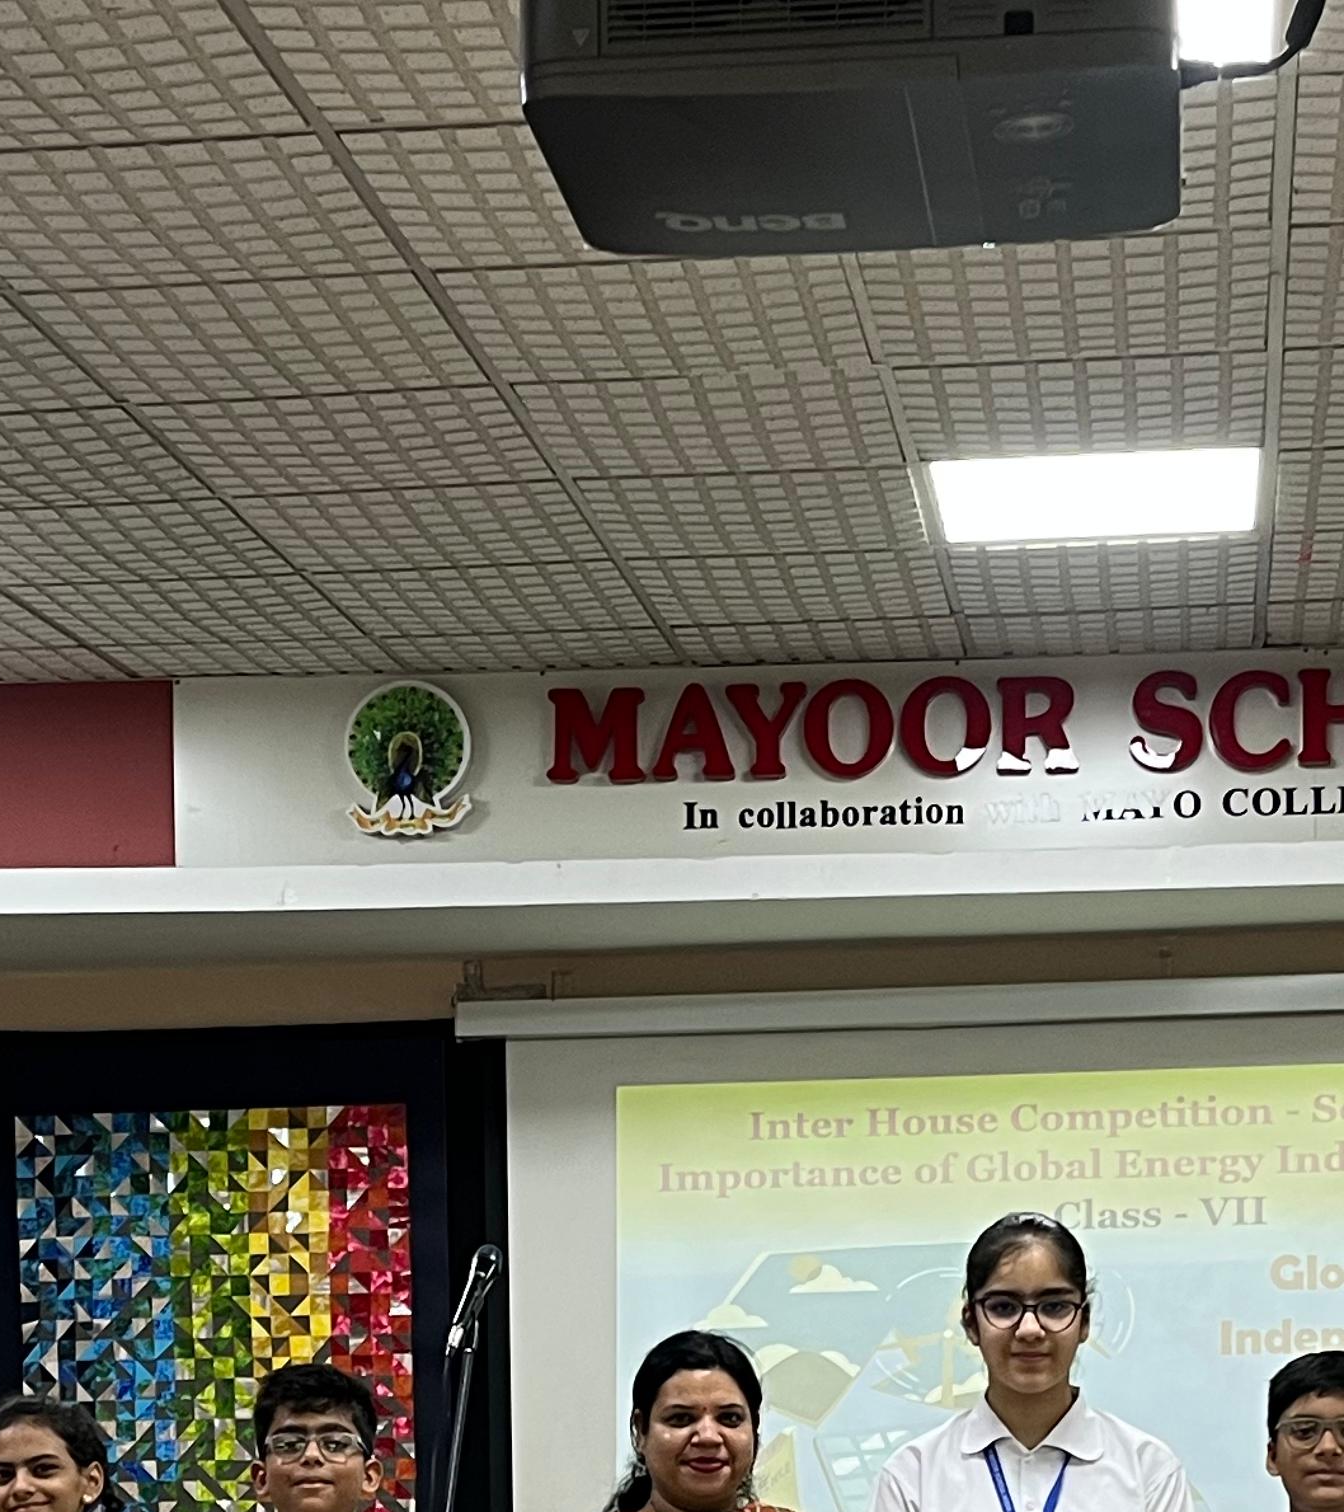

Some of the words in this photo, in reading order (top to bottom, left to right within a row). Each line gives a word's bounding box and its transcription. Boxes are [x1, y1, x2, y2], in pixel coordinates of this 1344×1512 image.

[546, 675, 1080, 785] MAYOOR
[683, 802, 719, 830] In
[738, 797, 964, 830] collaboration
[749, 1111, 854, 1140] Inter
[866, 1107, 998, 1137] House
[1010, 1095, 1272, 1138] Competition
[658, 1161, 903, 1199] Importance
[914, 1152, 959, 1185] of
[965, 1148, 1102, 1183] Global
[1114, 1149, 1264, 1184] Energy
[1055, 1198, 1161, 1230] Class
[1199, 1196, 1268, 1226] VII
